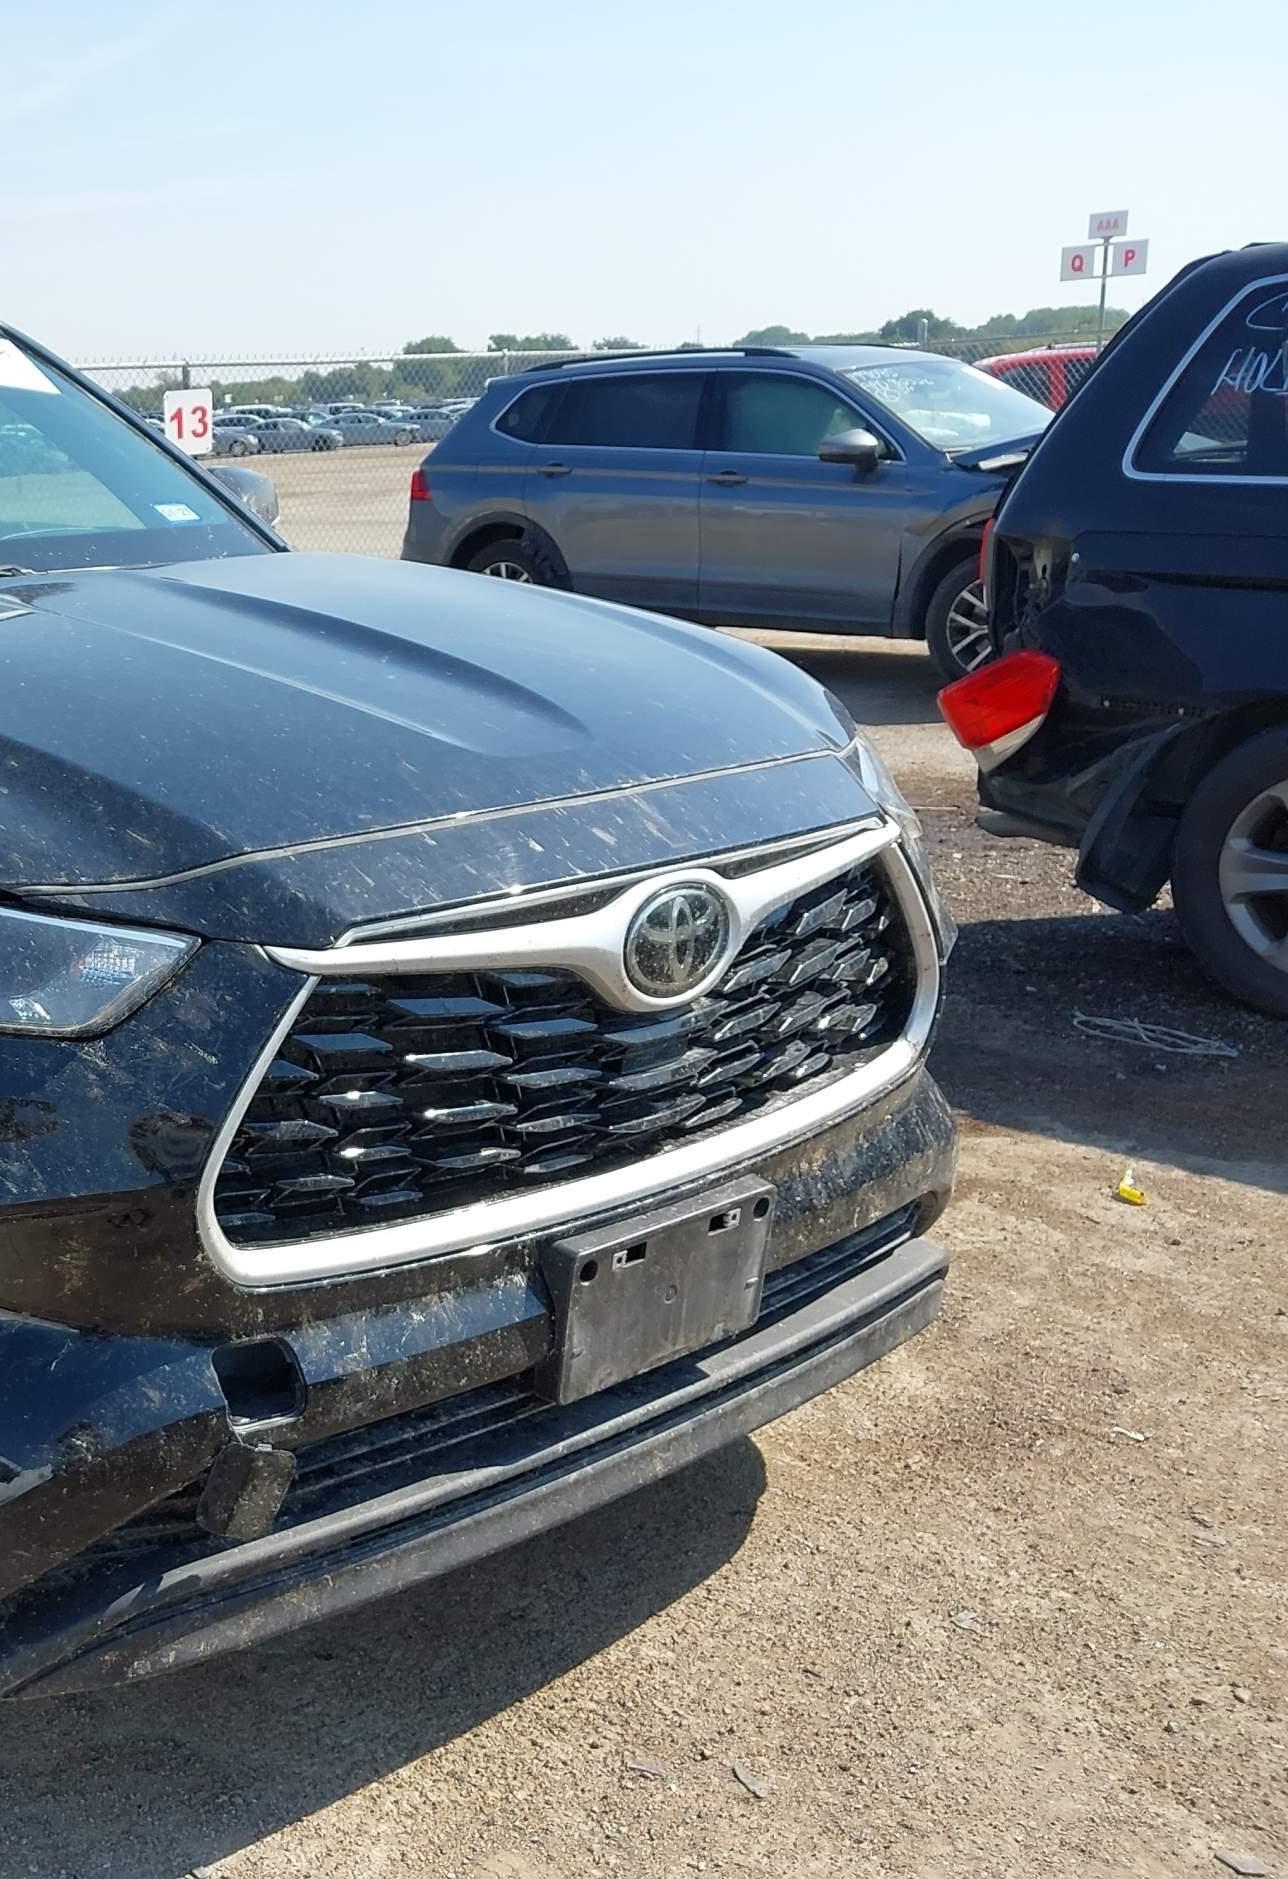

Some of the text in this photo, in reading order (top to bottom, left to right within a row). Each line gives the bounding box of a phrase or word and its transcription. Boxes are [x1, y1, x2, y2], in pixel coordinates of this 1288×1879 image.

[1071, 254, 1085, 272] Q
[1124, 249, 1136, 268] P
[169, 404, 208, 440] 13
